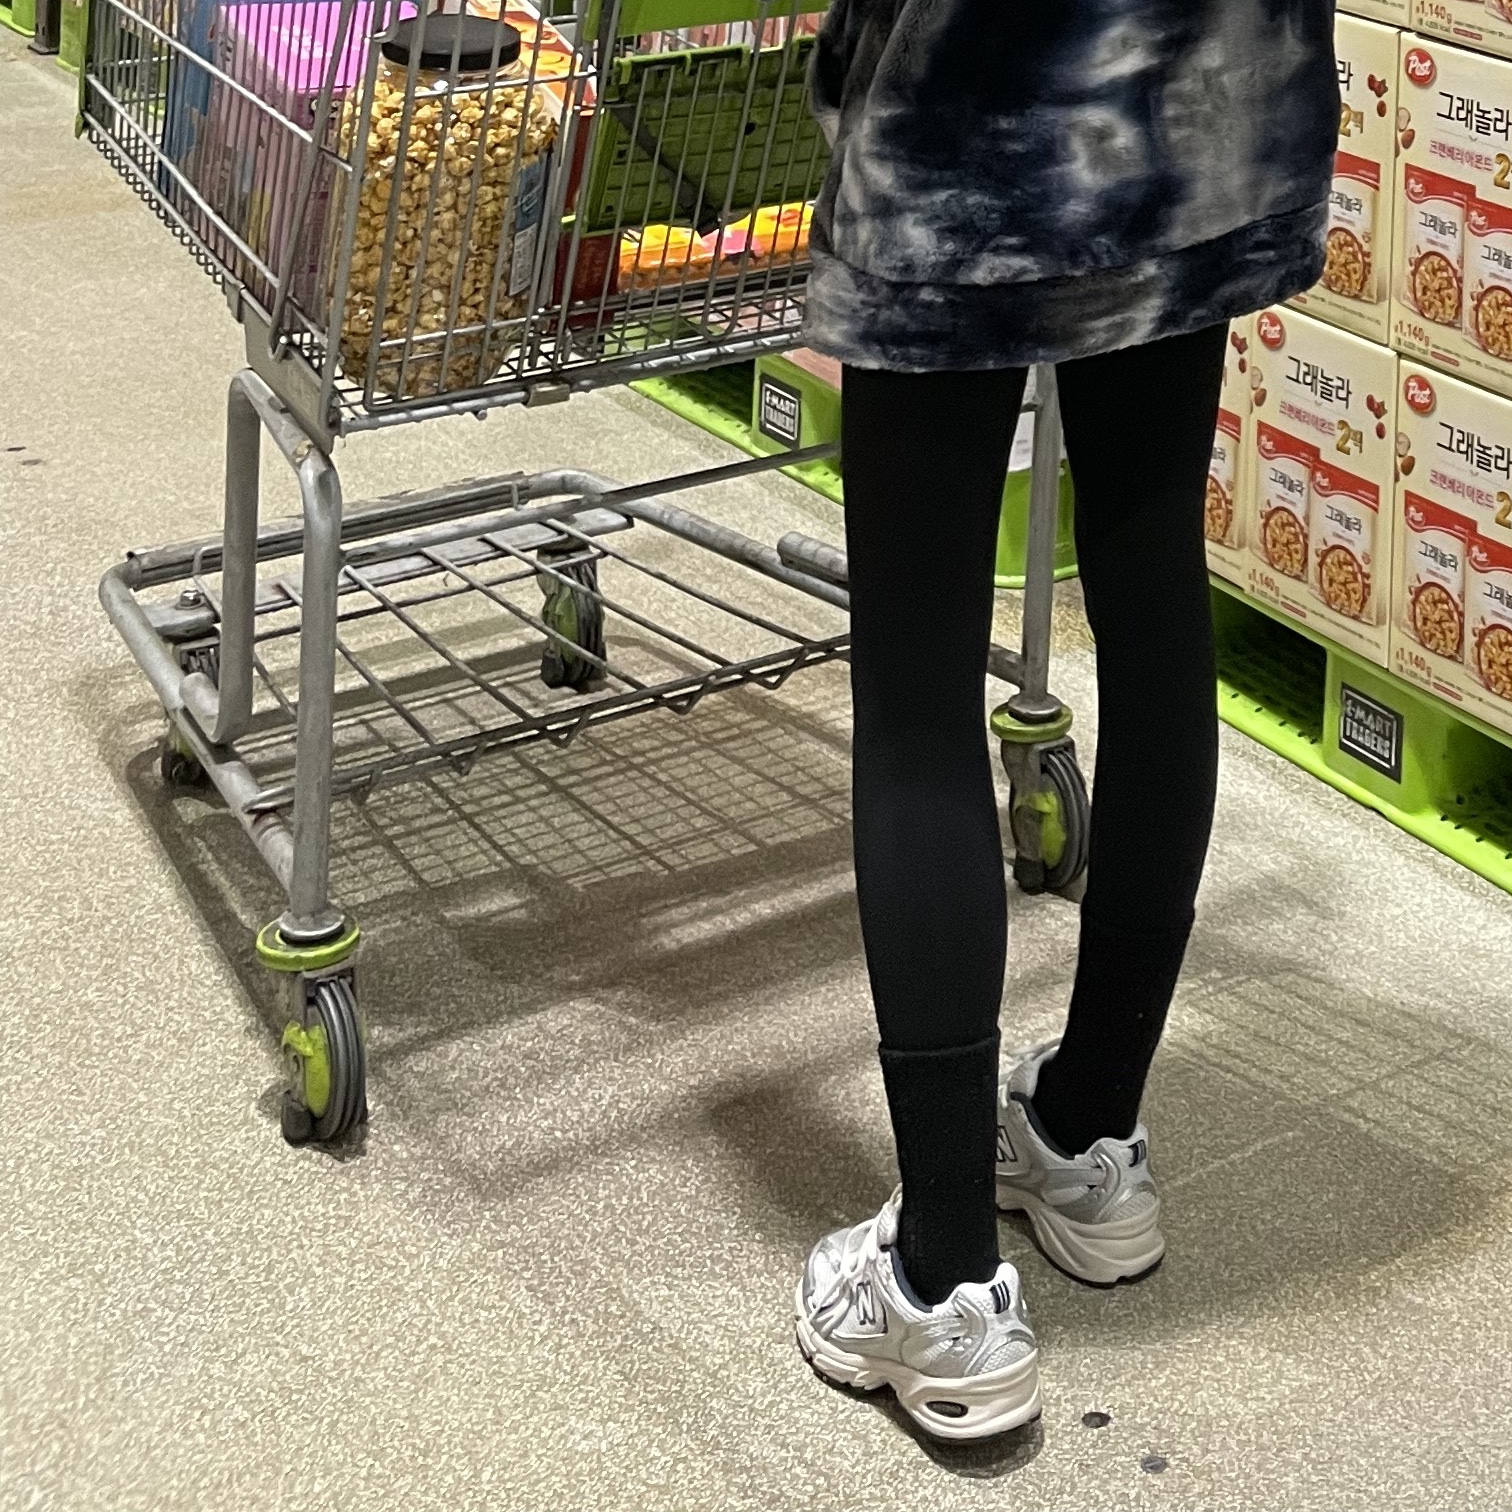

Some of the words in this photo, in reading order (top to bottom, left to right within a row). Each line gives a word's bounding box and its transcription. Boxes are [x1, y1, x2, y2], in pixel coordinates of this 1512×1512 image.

[1407, 58, 1433, 80] Post
[1436, 91, 1512, 141] 그래놀라
[1285, 355, 1352, 409] 그래놀라
[1406, 383, 1435, 407] Post
